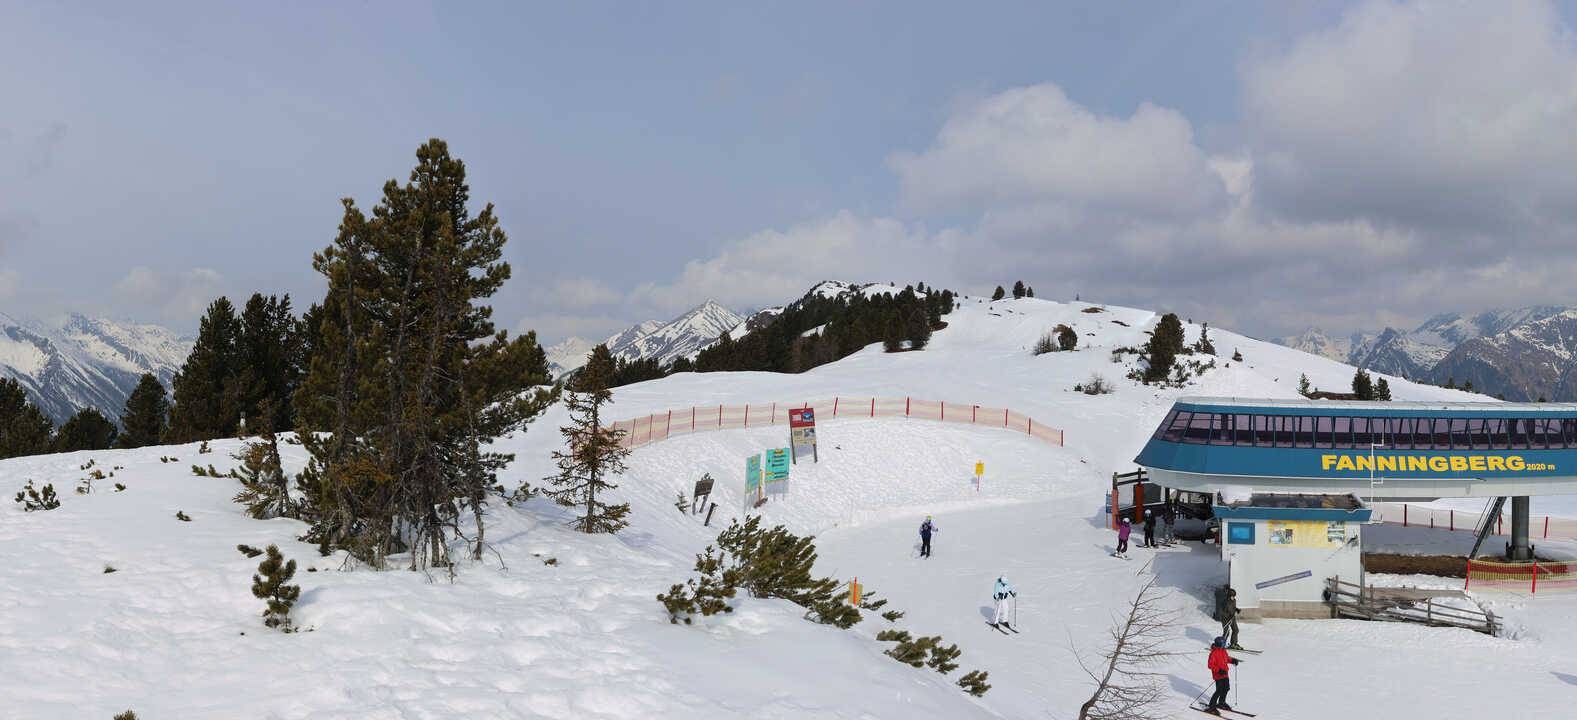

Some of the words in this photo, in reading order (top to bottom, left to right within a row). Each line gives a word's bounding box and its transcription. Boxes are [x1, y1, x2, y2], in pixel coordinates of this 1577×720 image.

[1321, 454, 1526, 472] FANNINGBERG
[1526, 462, 1546, 471] 2020
[1547, 463, 1556, 471] m
